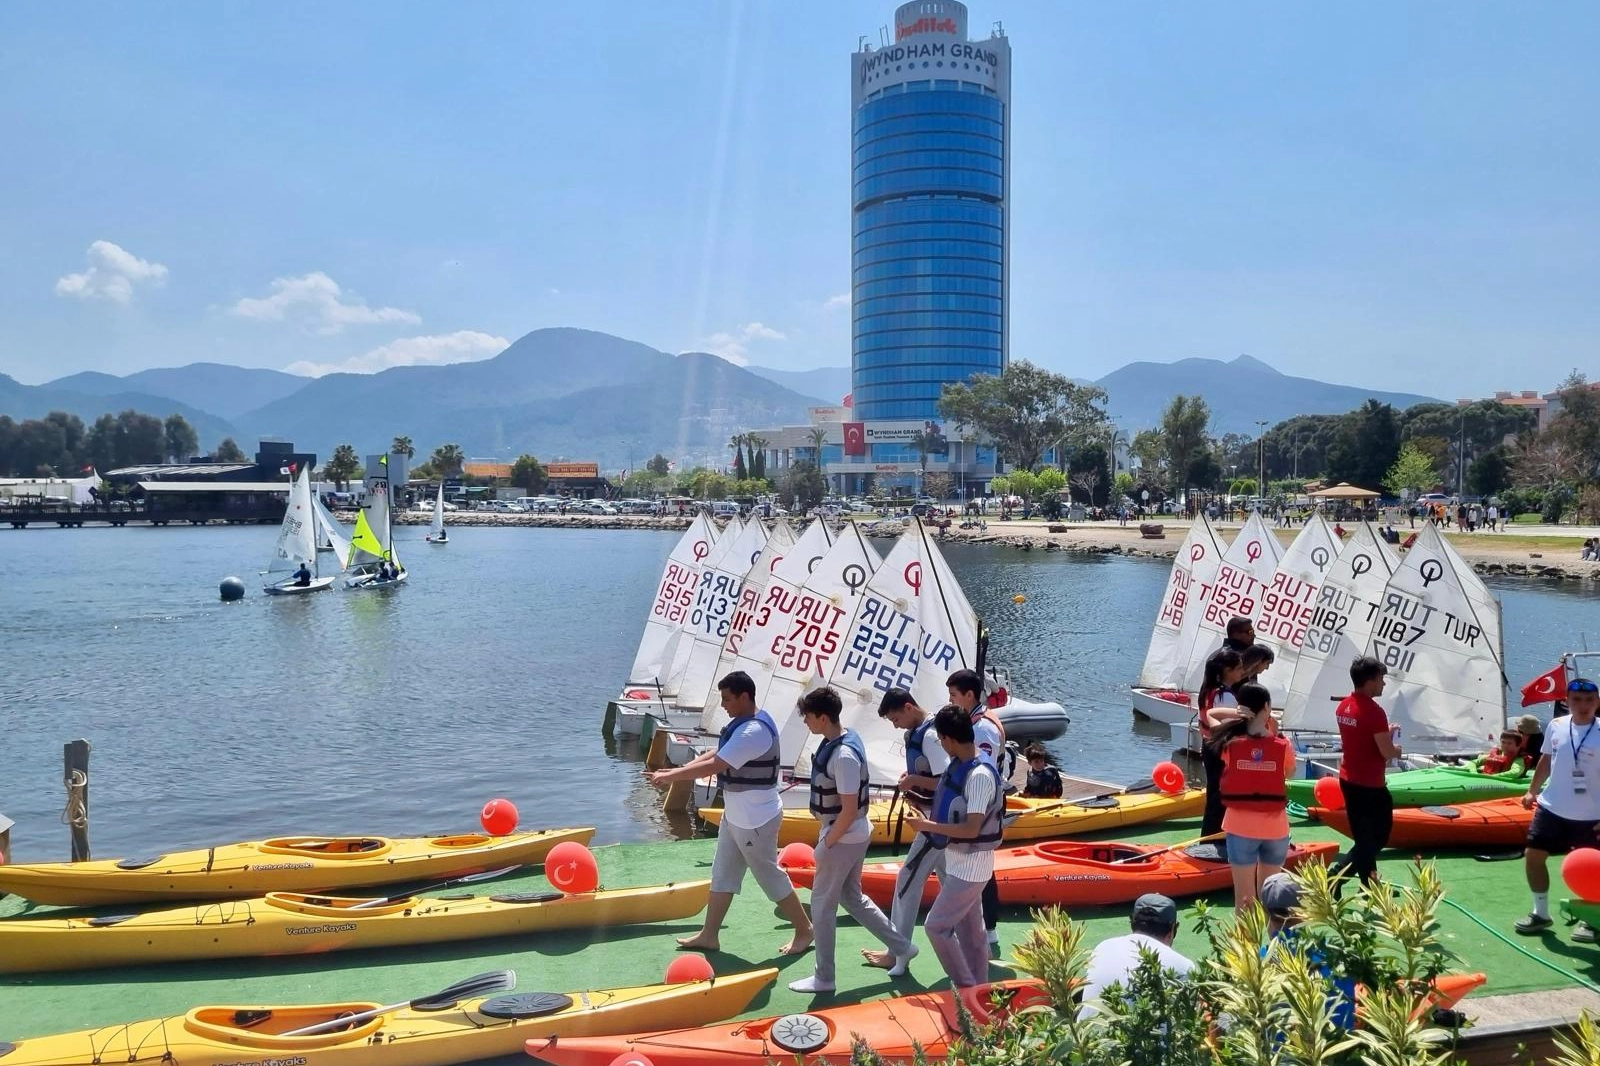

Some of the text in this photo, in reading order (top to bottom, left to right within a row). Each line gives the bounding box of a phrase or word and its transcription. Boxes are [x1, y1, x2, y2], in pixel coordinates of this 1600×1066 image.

[866, 43, 998, 72] WYNDHAM GRAND
[660, 580, 695, 607] 1515
[1210, 584, 1255, 616] 1528
[1311, 606, 1348, 636] 1182
[1376, 616, 1427, 647] 1187
[1443, 612, 1481, 648] TUR
[788, 618, 840, 655] 705
[252, 861, 314, 872] Venture Kayaks
[1055, 874, 1111, 882] Venture Kayaks
[286, 922, 357, 936] Venture Kayaks
